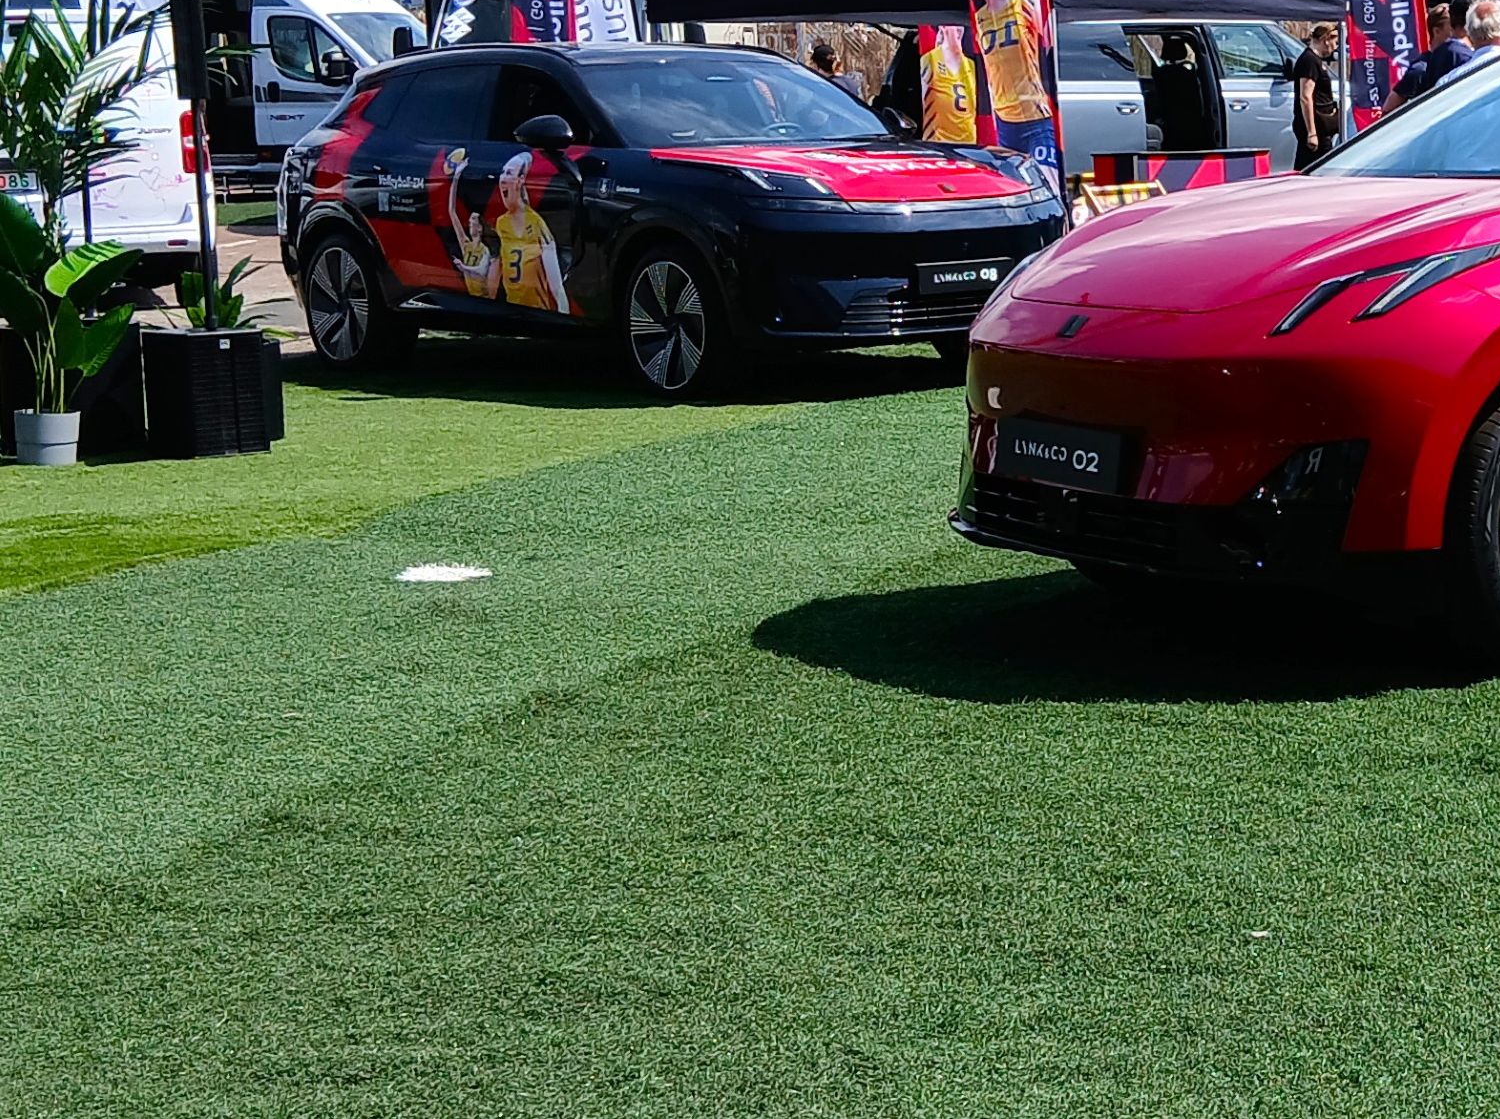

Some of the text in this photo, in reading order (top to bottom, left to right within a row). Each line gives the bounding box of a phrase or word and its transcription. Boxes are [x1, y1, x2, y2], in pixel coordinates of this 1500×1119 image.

[508, 249, 523, 283] 3
[979, 268, 998, 282] 08
[1072, 449, 1100, 473] 02
